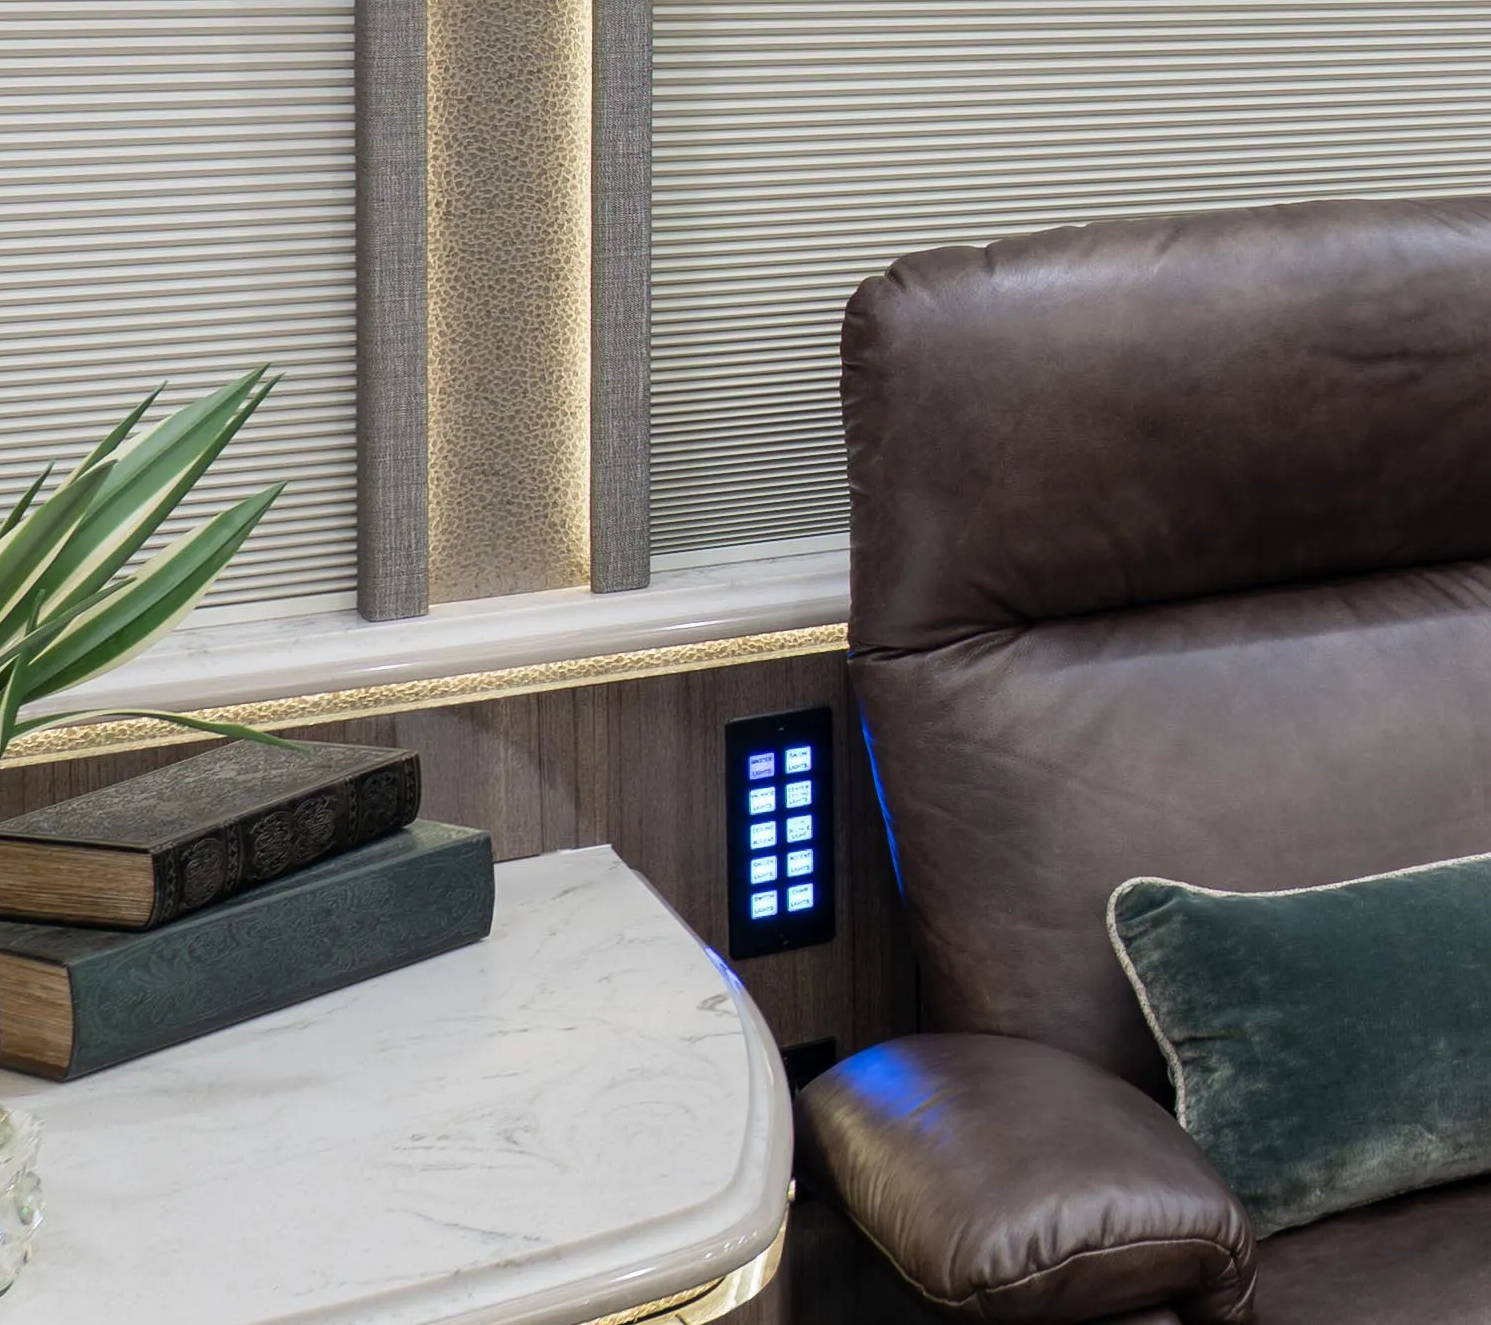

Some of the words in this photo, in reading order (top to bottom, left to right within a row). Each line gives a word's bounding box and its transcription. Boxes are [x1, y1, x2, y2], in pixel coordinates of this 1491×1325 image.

[751, 756, 772, 764] MASTER
[752, 768, 771, 776] LIGHTS
[753, 803, 772, 811] LIGHTS
[790, 852, 810, 860] ACCENT
[754, 871, 773, 880] LIGHTS
[790, 898, 809, 907] LIGHTS
[754, 905, 774, 914] LIGHTS
